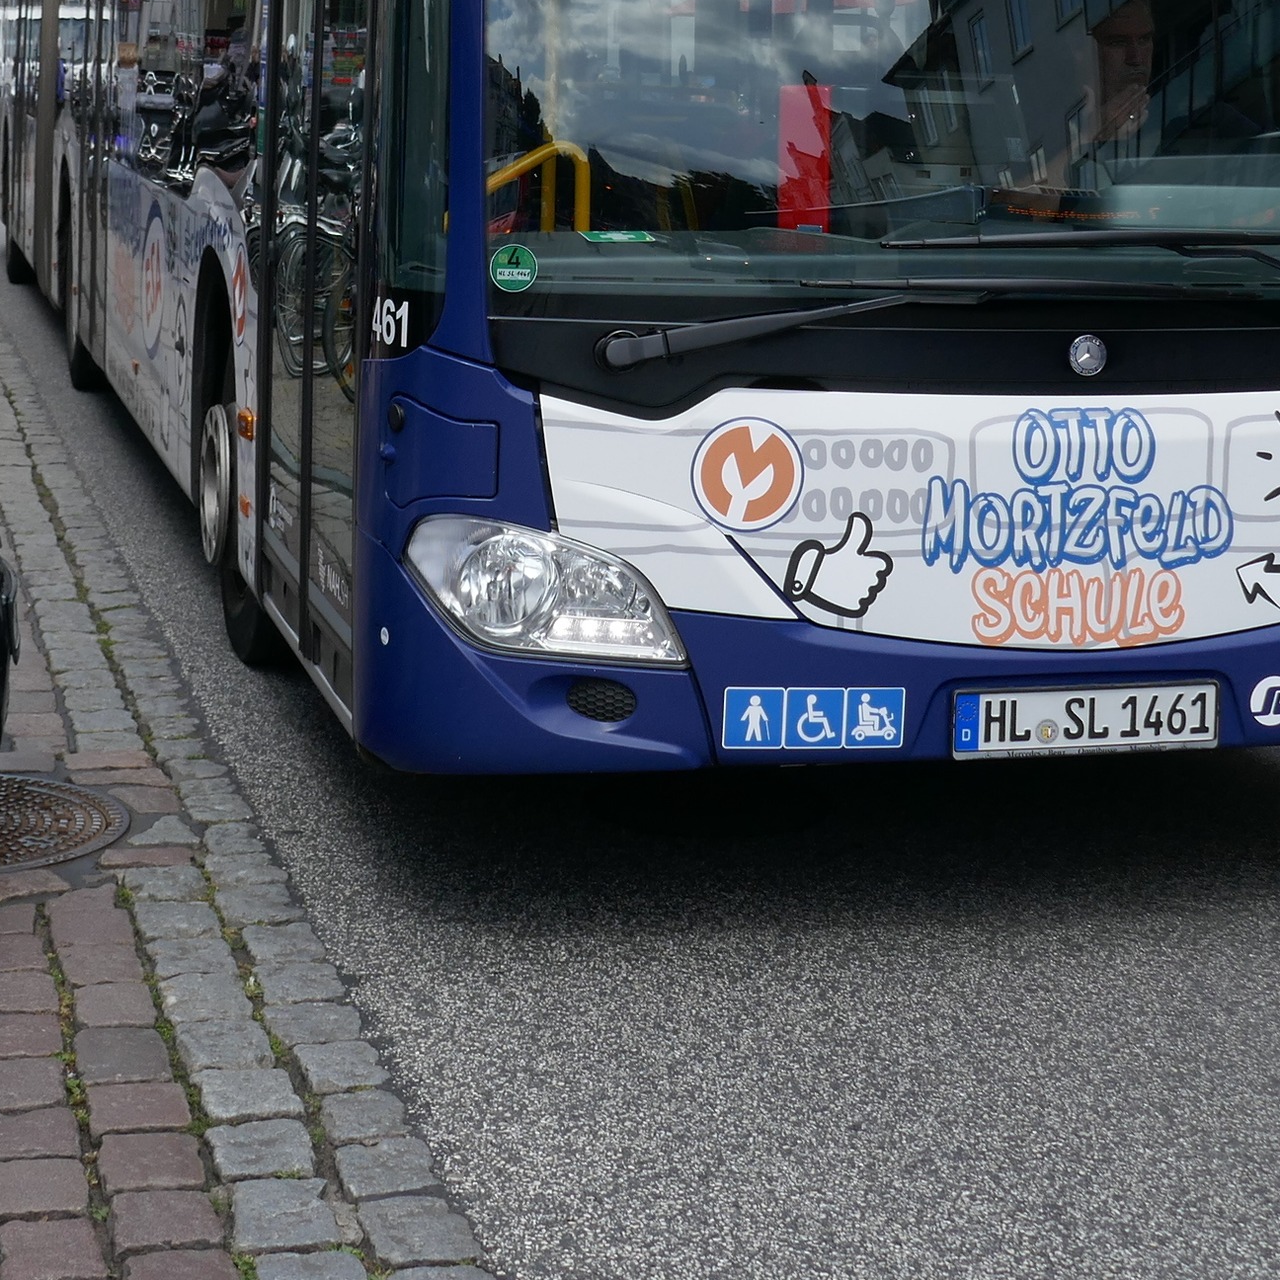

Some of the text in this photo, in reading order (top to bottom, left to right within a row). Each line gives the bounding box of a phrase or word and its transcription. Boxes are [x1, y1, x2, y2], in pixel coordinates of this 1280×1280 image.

[507, 247, 521, 268] 4
[372, 296, 409, 348] 461
[1012, 407, 1157, 485] OTTO
[962, 692, 1210, 743] D HL SL 1461
